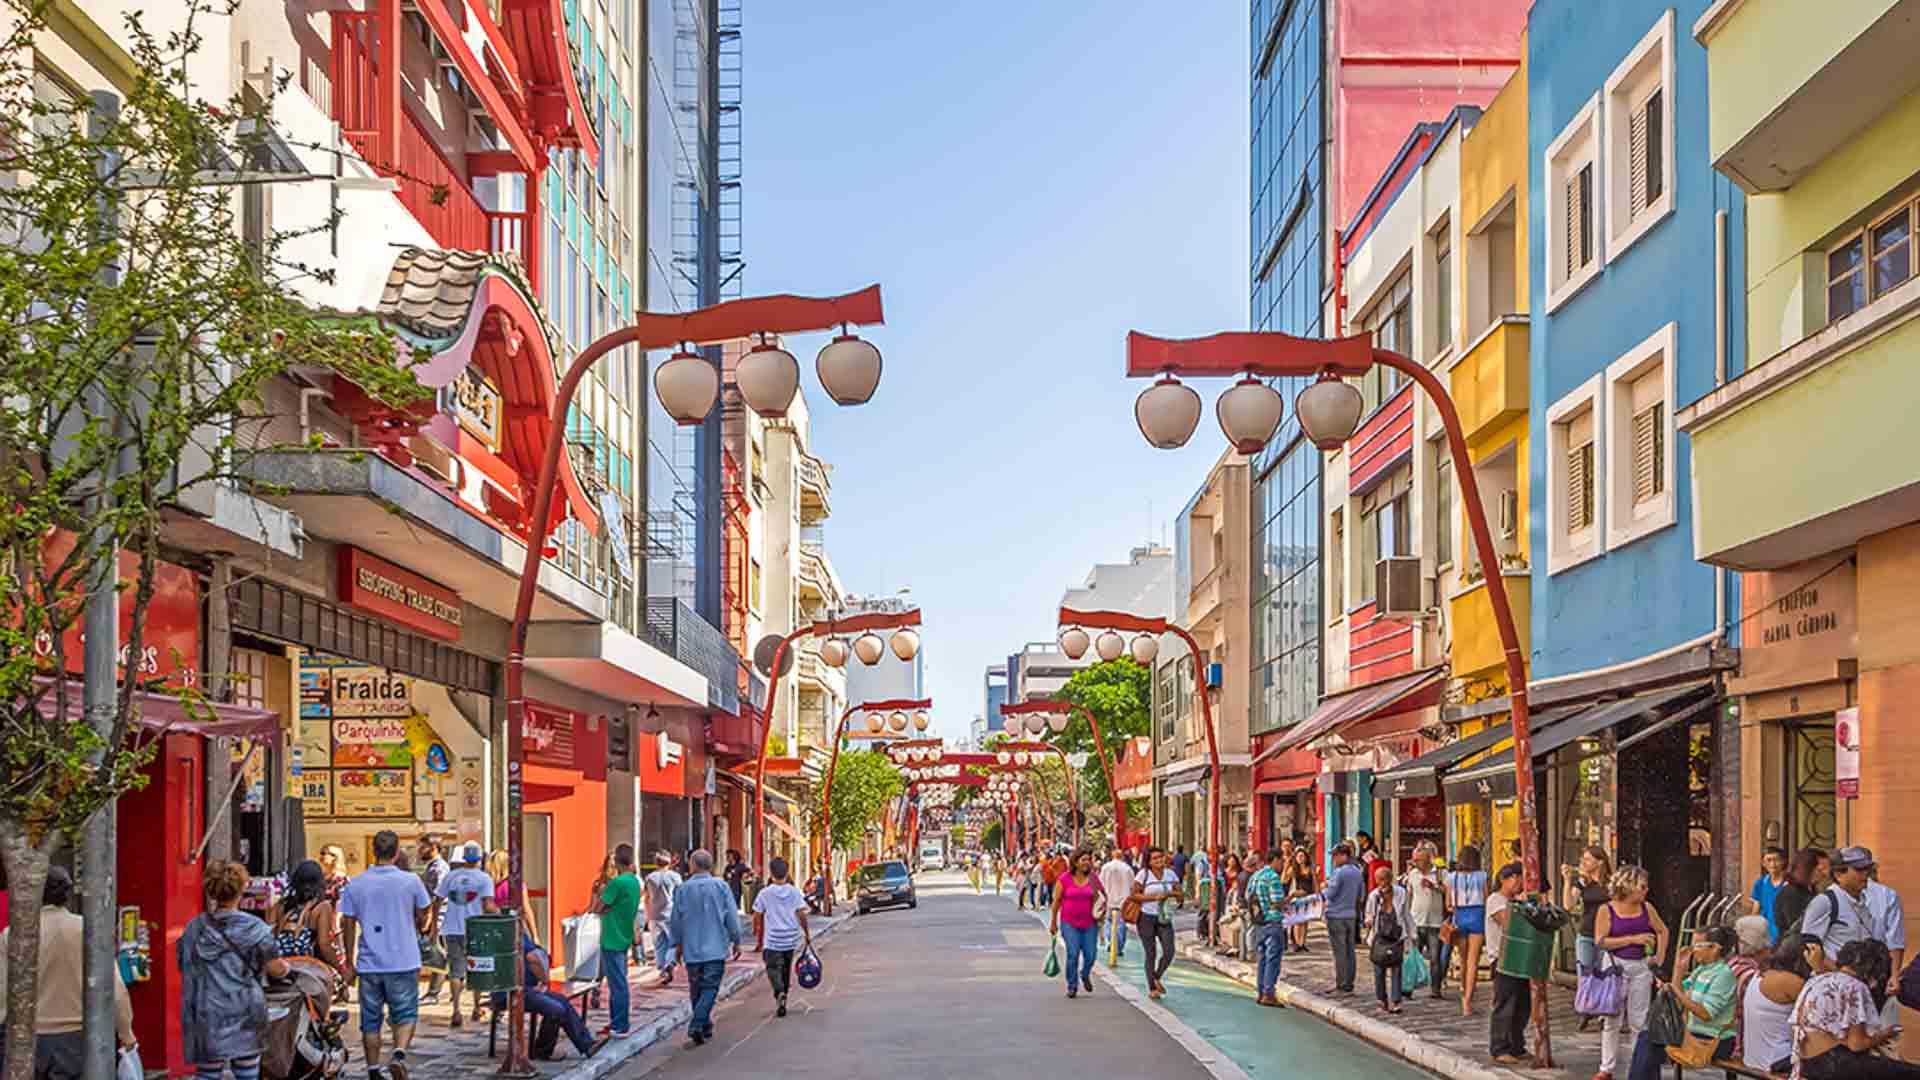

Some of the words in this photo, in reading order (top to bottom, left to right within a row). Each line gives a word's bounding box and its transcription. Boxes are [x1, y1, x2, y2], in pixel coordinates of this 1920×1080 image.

[359, 566, 406, 605] SHOPPING
[406, 586, 435, 616] TRADE
[434, 598, 463, 627] CENTER
[335, 676, 407, 700] Fralda
[337, 720, 406, 742] Parquinho
